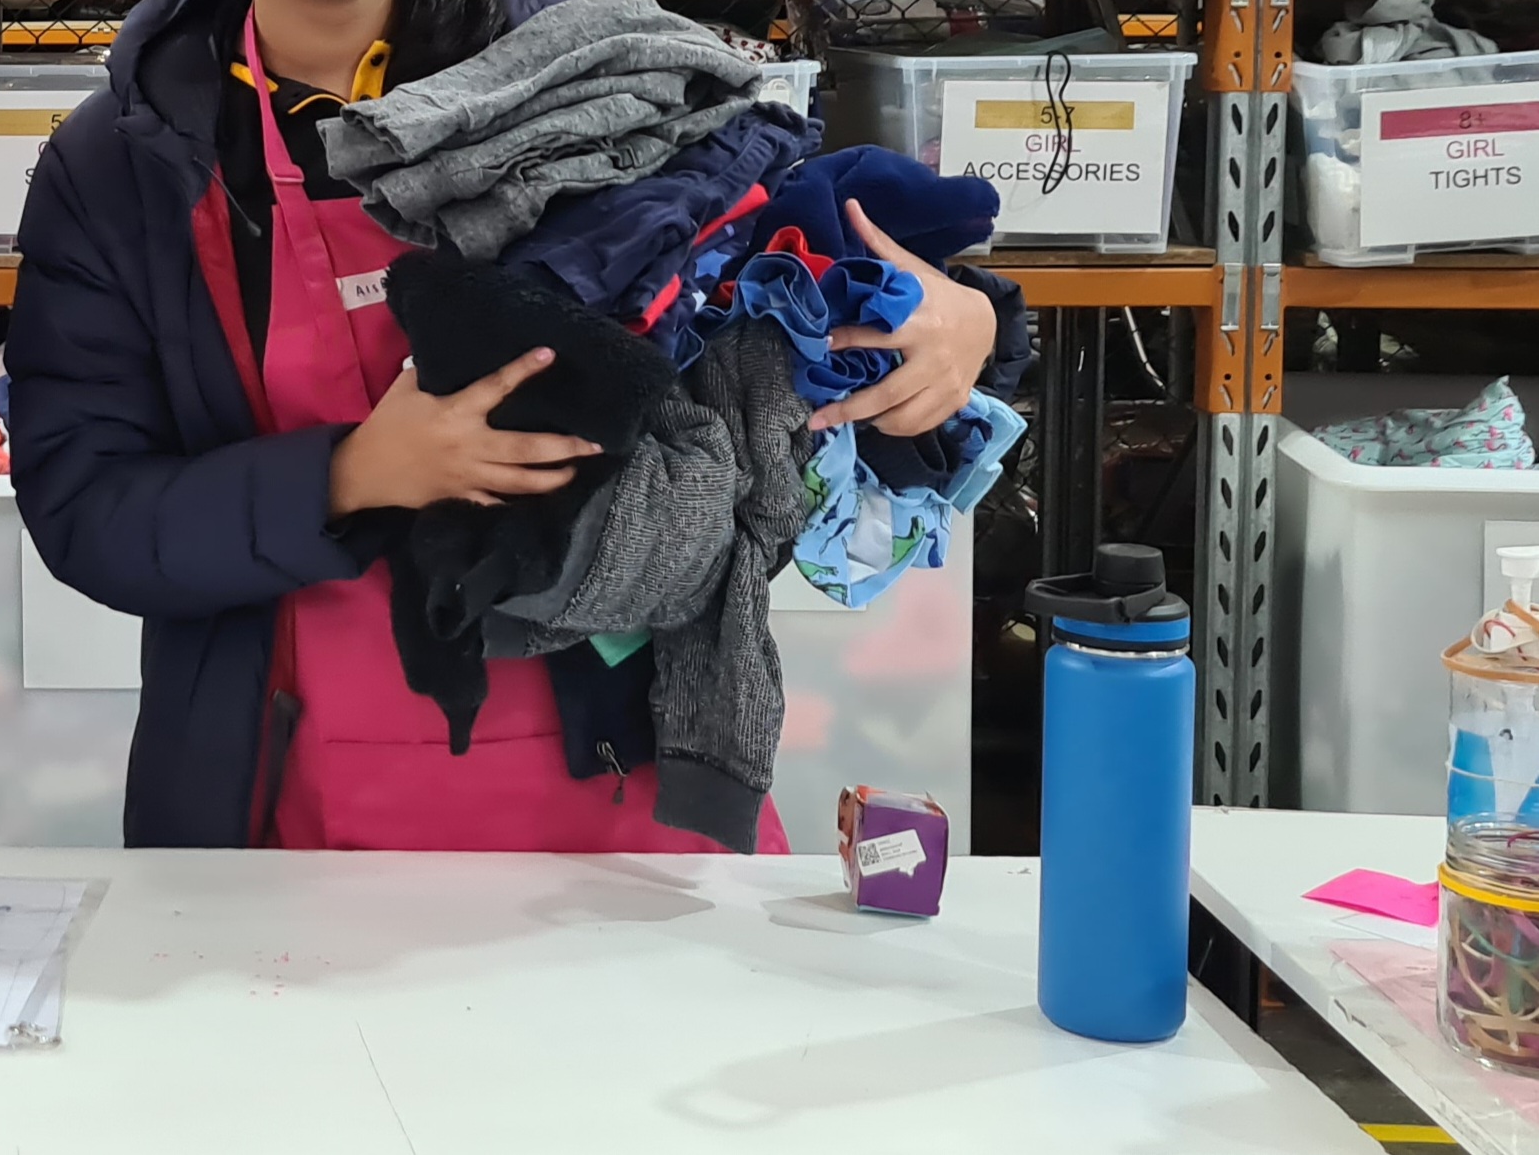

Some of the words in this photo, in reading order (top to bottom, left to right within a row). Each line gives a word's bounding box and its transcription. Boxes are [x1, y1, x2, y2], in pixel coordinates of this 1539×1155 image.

[1460, 111, 1488, 129] 8+
[1026, 134, 1081, 152] GIRL
[1445, 139, 1504, 160] GIRL
[962, 161, 1140, 182] ACCESSORIES
[1429, 166, 1522, 190] TIGHTS
